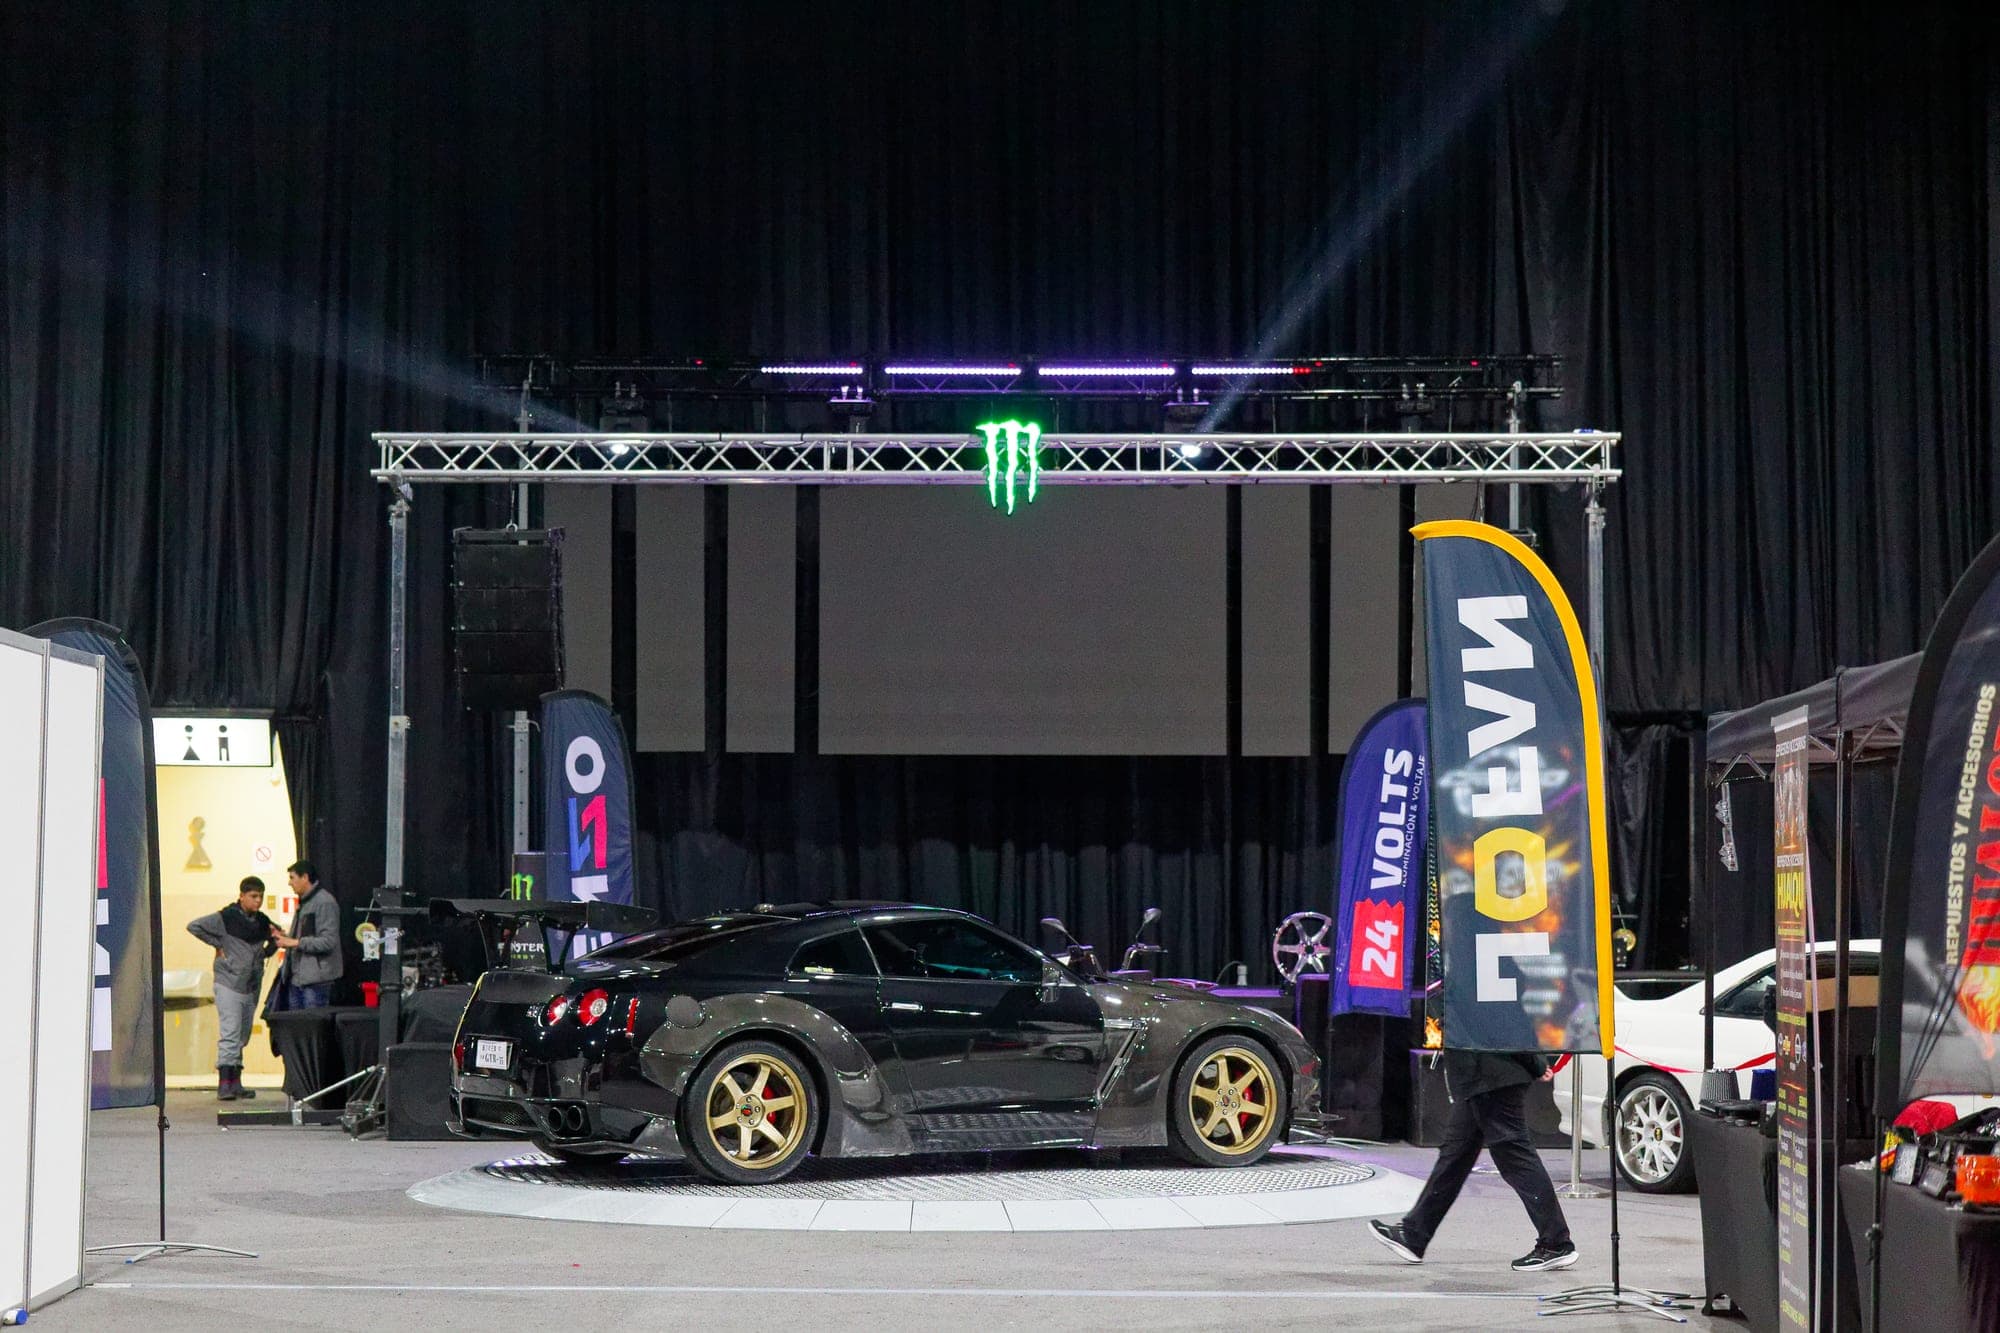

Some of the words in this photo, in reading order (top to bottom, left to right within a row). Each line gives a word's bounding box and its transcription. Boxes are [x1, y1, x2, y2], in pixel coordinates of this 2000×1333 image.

[1956, 683, 1997, 819] ACCESORIOS
[1370, 748, 1414, 889] VOLTS
[1953, 822, 1970, 837] Y
[1361, 919, 1399, 978] 24
[1945, 841, 1967, 966] REPUESTOS
